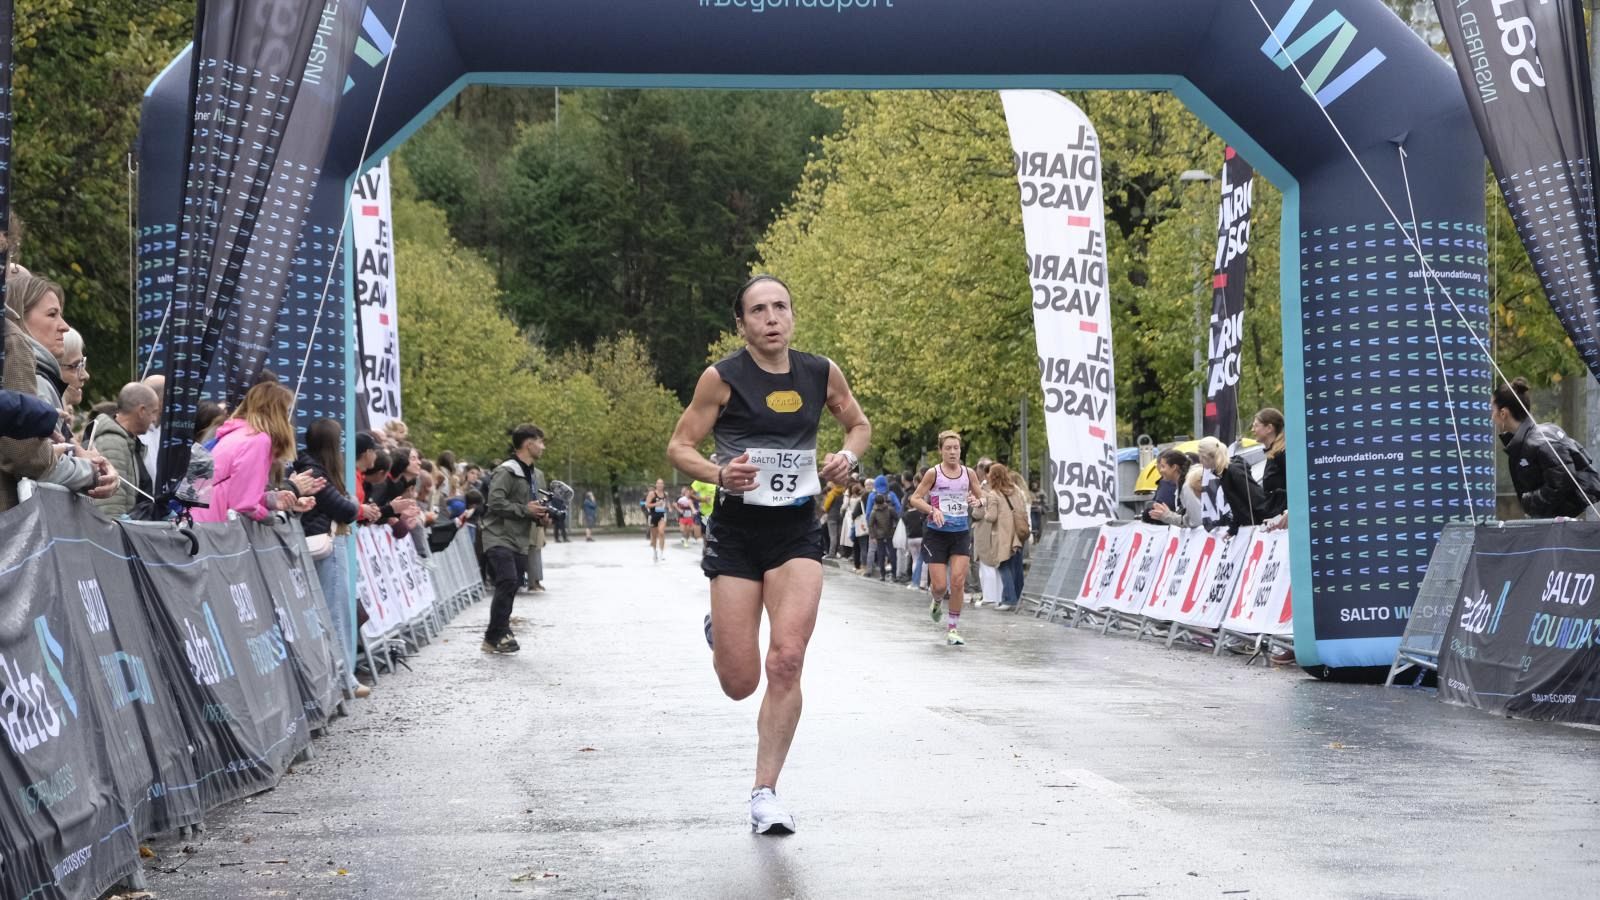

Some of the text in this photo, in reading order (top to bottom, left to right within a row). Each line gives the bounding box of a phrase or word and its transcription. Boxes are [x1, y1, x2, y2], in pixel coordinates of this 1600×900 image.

[751, 456, 776, 464] SALTO
[1313, 451, 1404, 465] saltofoundation.org
[770, 473, 799, 493] 63
[947, 503, 962, 511] 143
[1541, 570, 1595, 605] SALTO
[1340, 606, 1390, 621] SALTO
